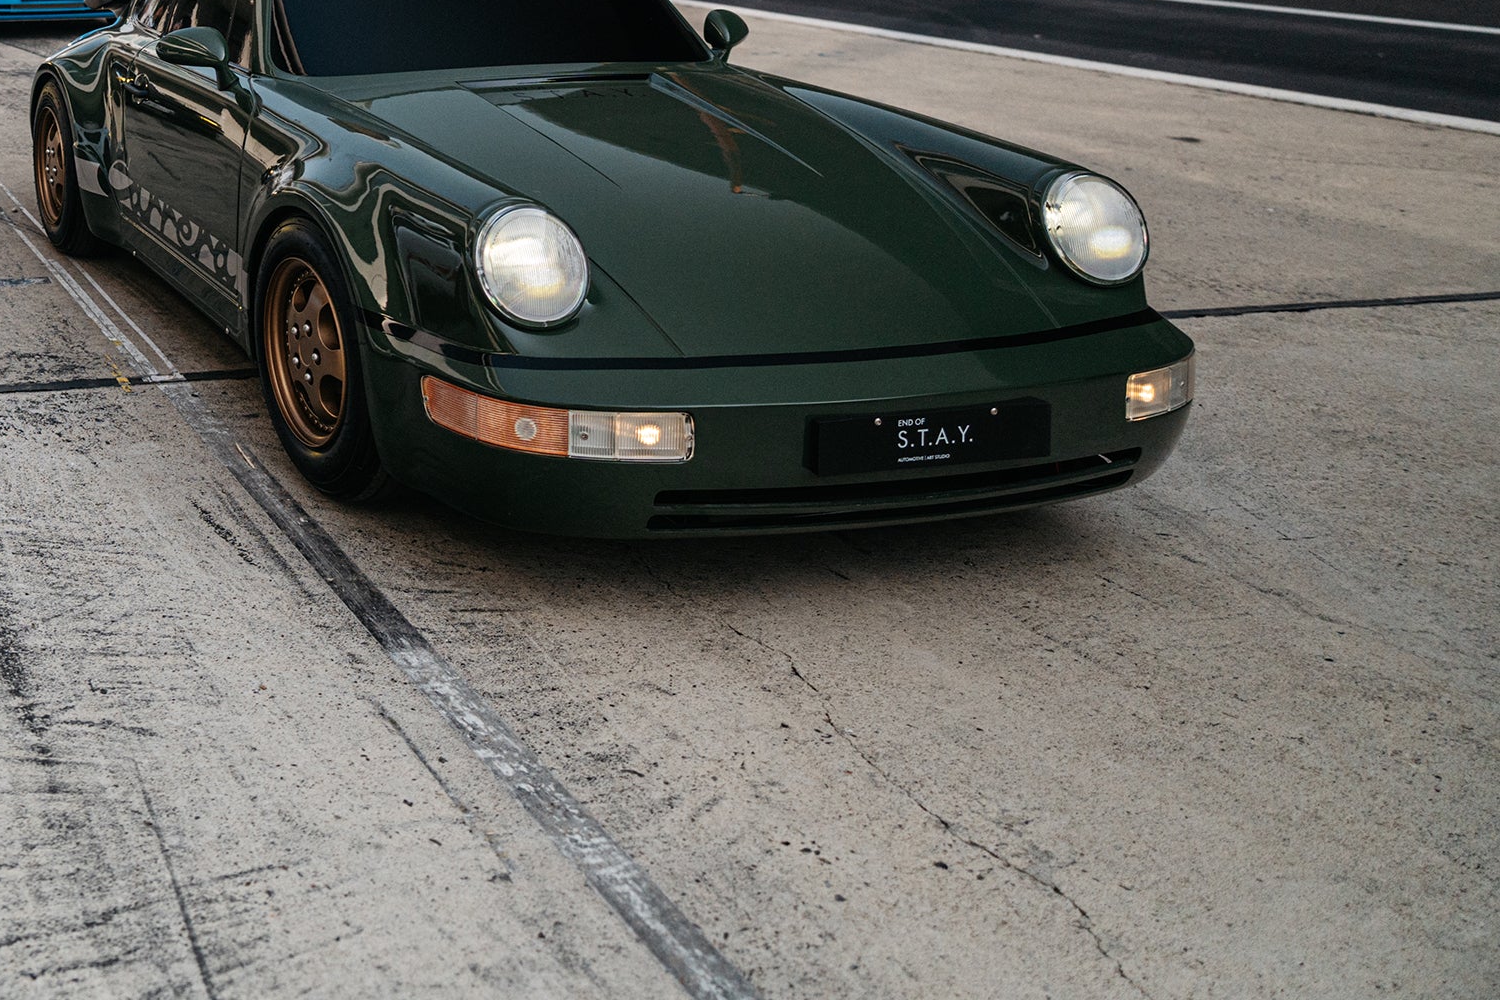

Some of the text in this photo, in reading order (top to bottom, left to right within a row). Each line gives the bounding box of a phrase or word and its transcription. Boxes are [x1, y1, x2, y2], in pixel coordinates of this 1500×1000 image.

[898, 418, 925, 427] END OF
[898, 425, 973, 448] S.T.A.Y.
